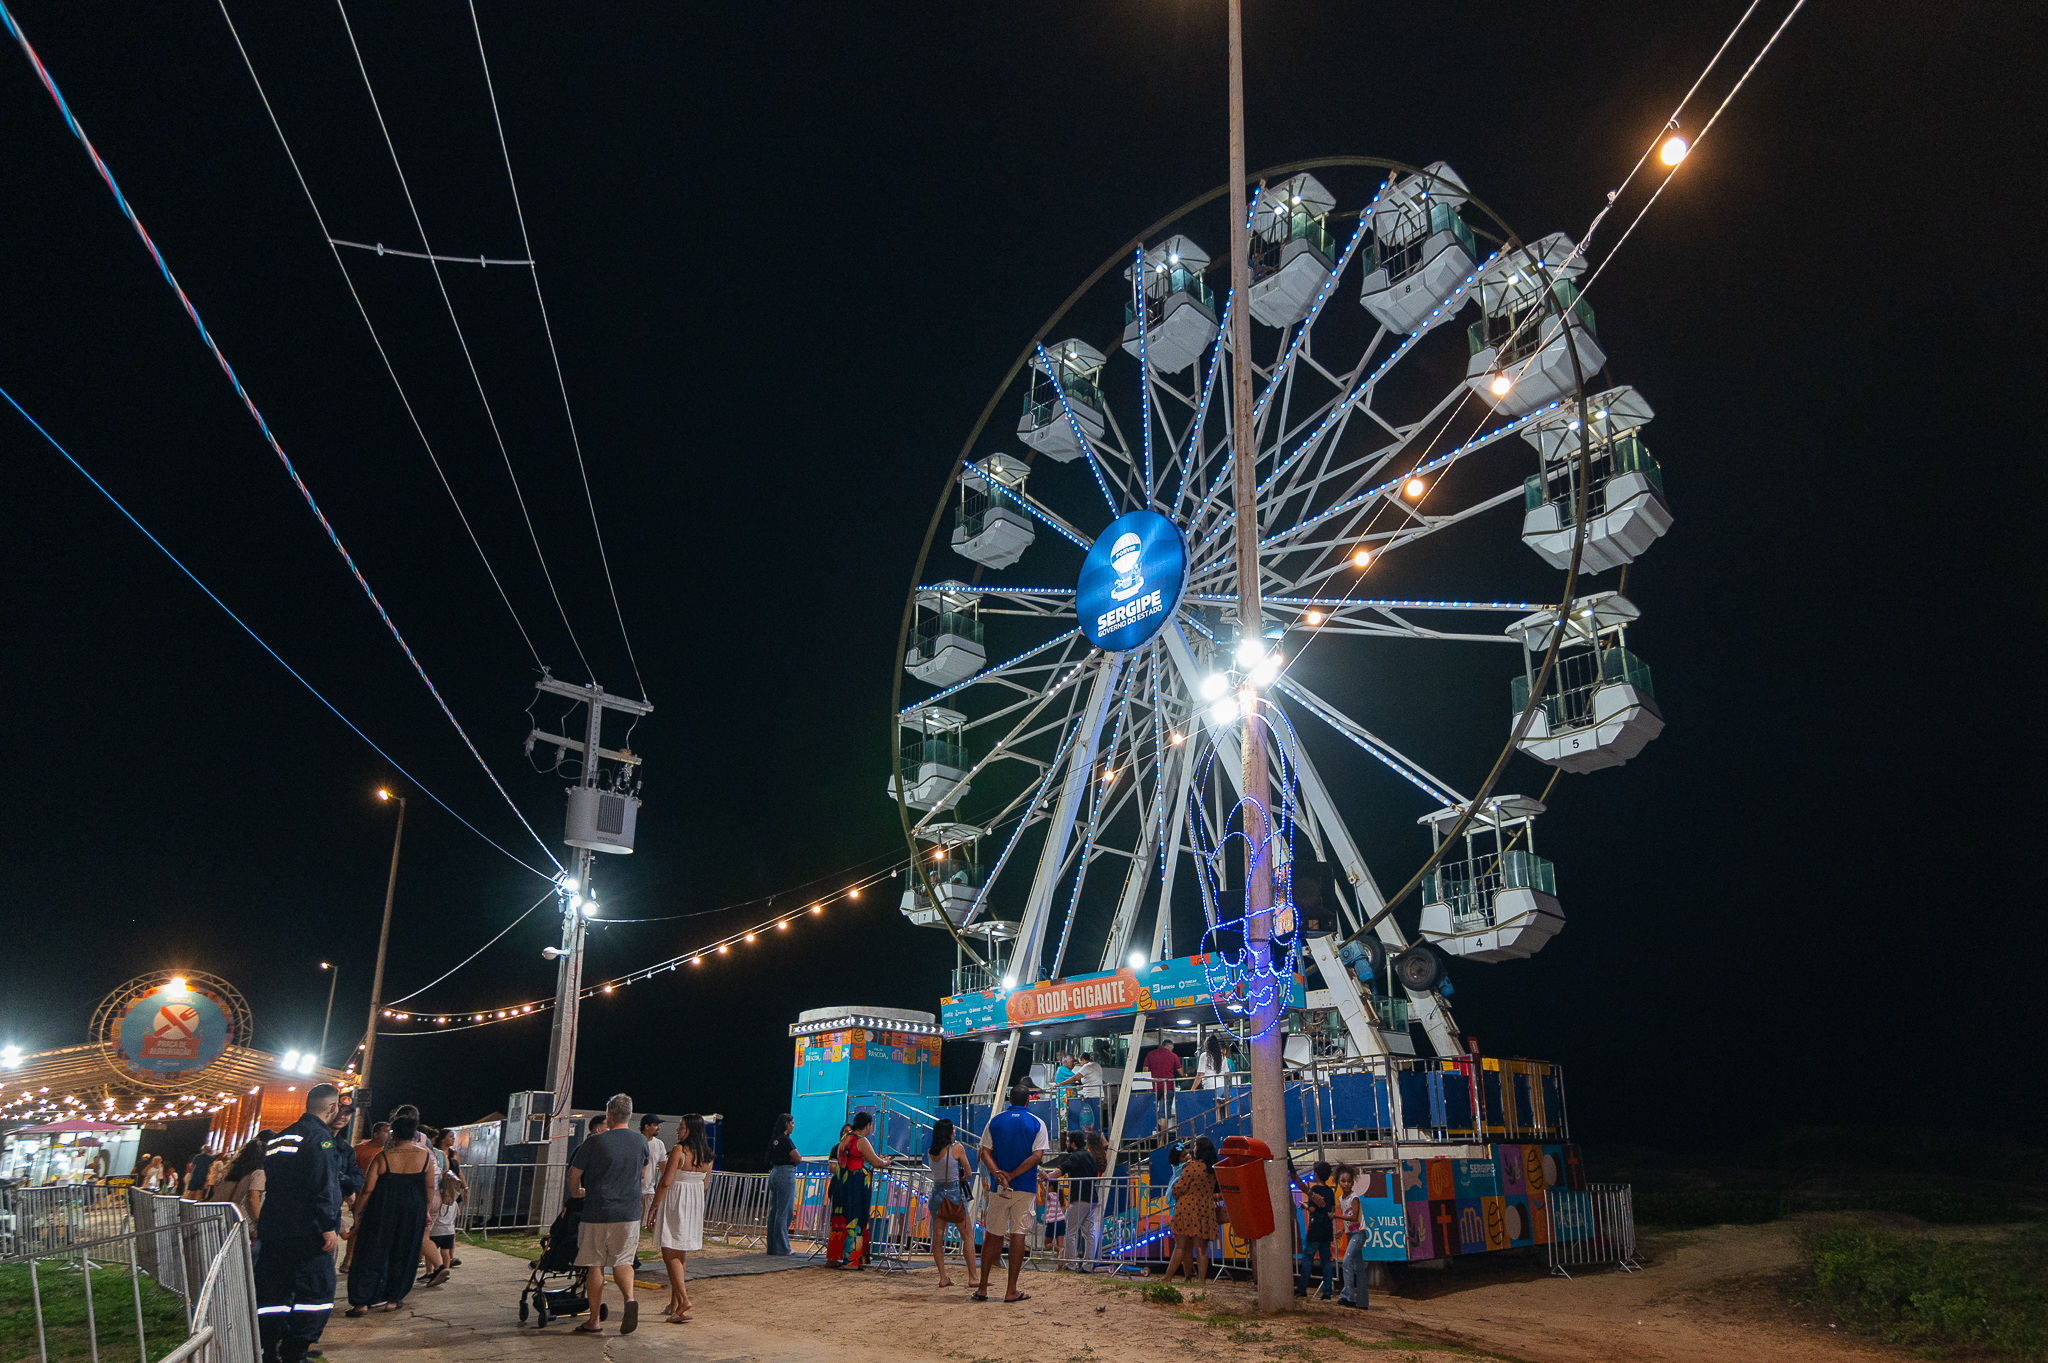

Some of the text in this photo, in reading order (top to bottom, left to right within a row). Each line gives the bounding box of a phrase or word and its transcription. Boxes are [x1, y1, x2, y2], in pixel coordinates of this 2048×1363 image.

[1406, 285, 1411, 293] 8
[1152, 335, 1156, 343] 2
[1097, 589, 1162, 631] SERGIPE
[1097, 604, 1163, 638] GOVERNO DO ESTADO
[1573, 739, 1579, 748] 5
[1476, 938, 1482, 947] 4
[1036, 980, 1126, 1015] RODA-GIGANTE
[1470, 1163, 1495, 1174] SERGIPE
[1377, 1216, 1398, 1226] VILA
[1363, 1227, 1406, 1249] PÁSC
